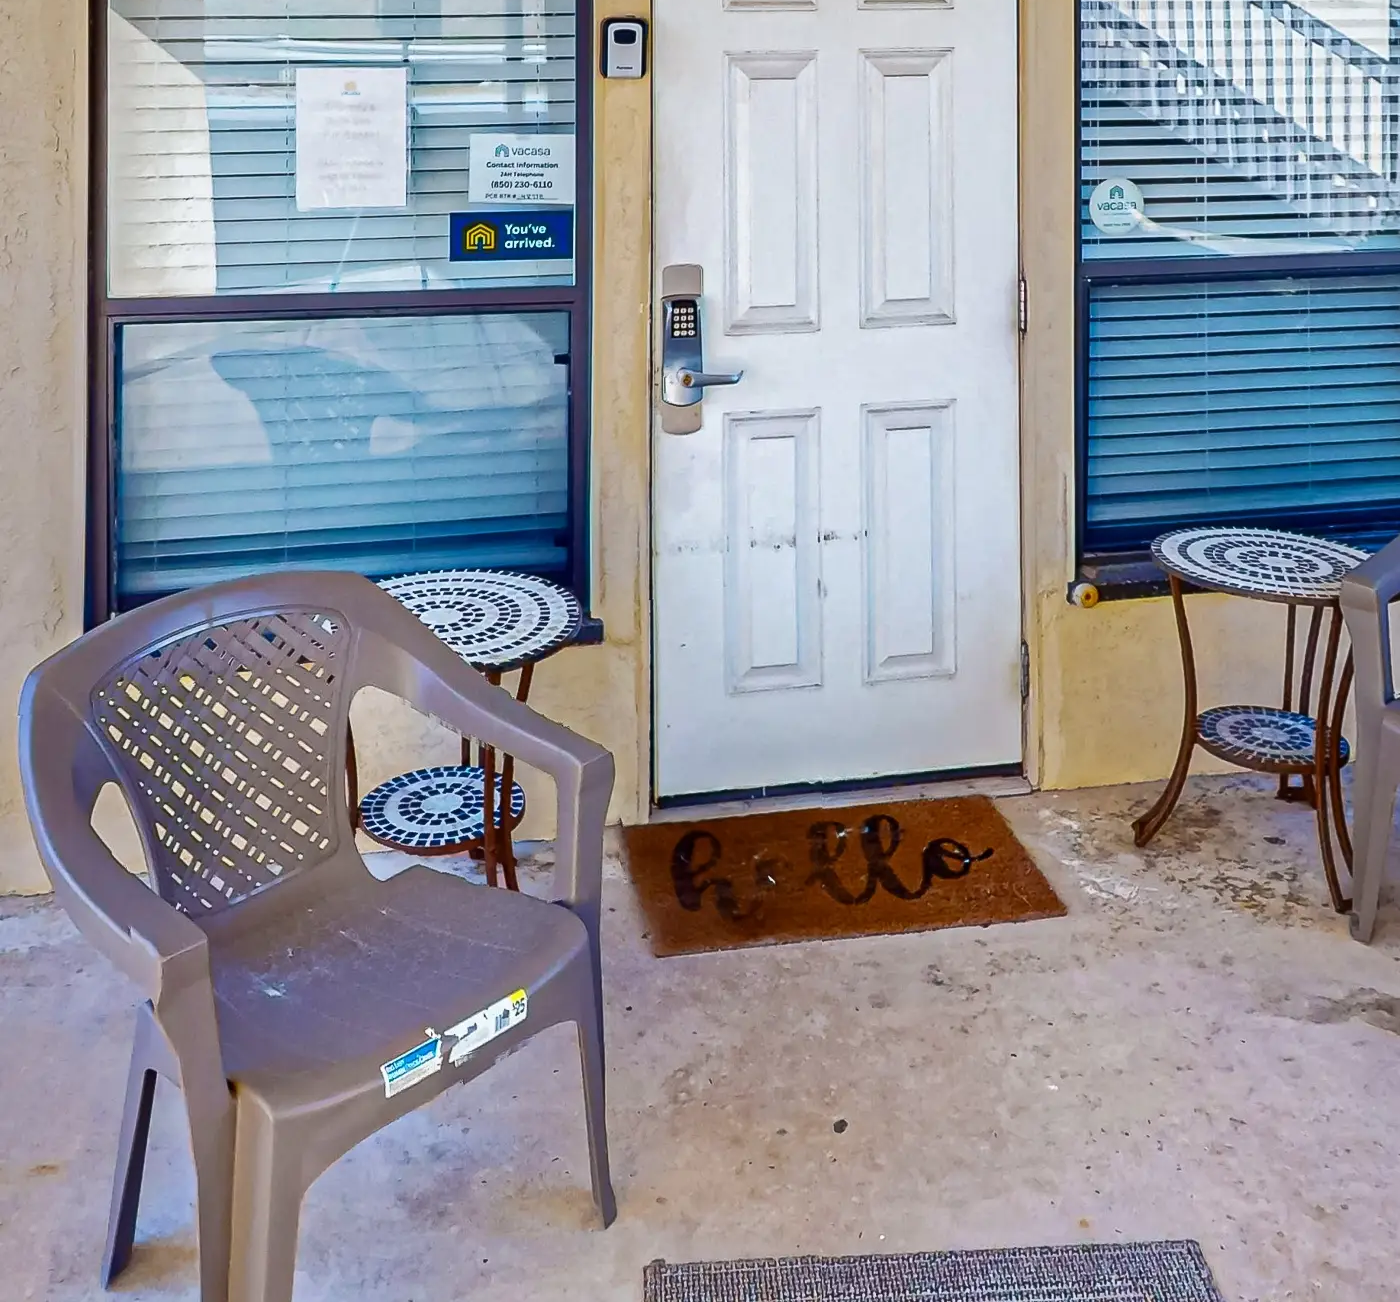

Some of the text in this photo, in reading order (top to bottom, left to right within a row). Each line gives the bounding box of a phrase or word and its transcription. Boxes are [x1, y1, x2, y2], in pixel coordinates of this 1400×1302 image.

[511, 147, 551, 156] vacasa
[490, 180, 553, 189] (850) 230-6110
[504, 223, 547, 235] You've
[504, 236, 556, 249] arrived.
